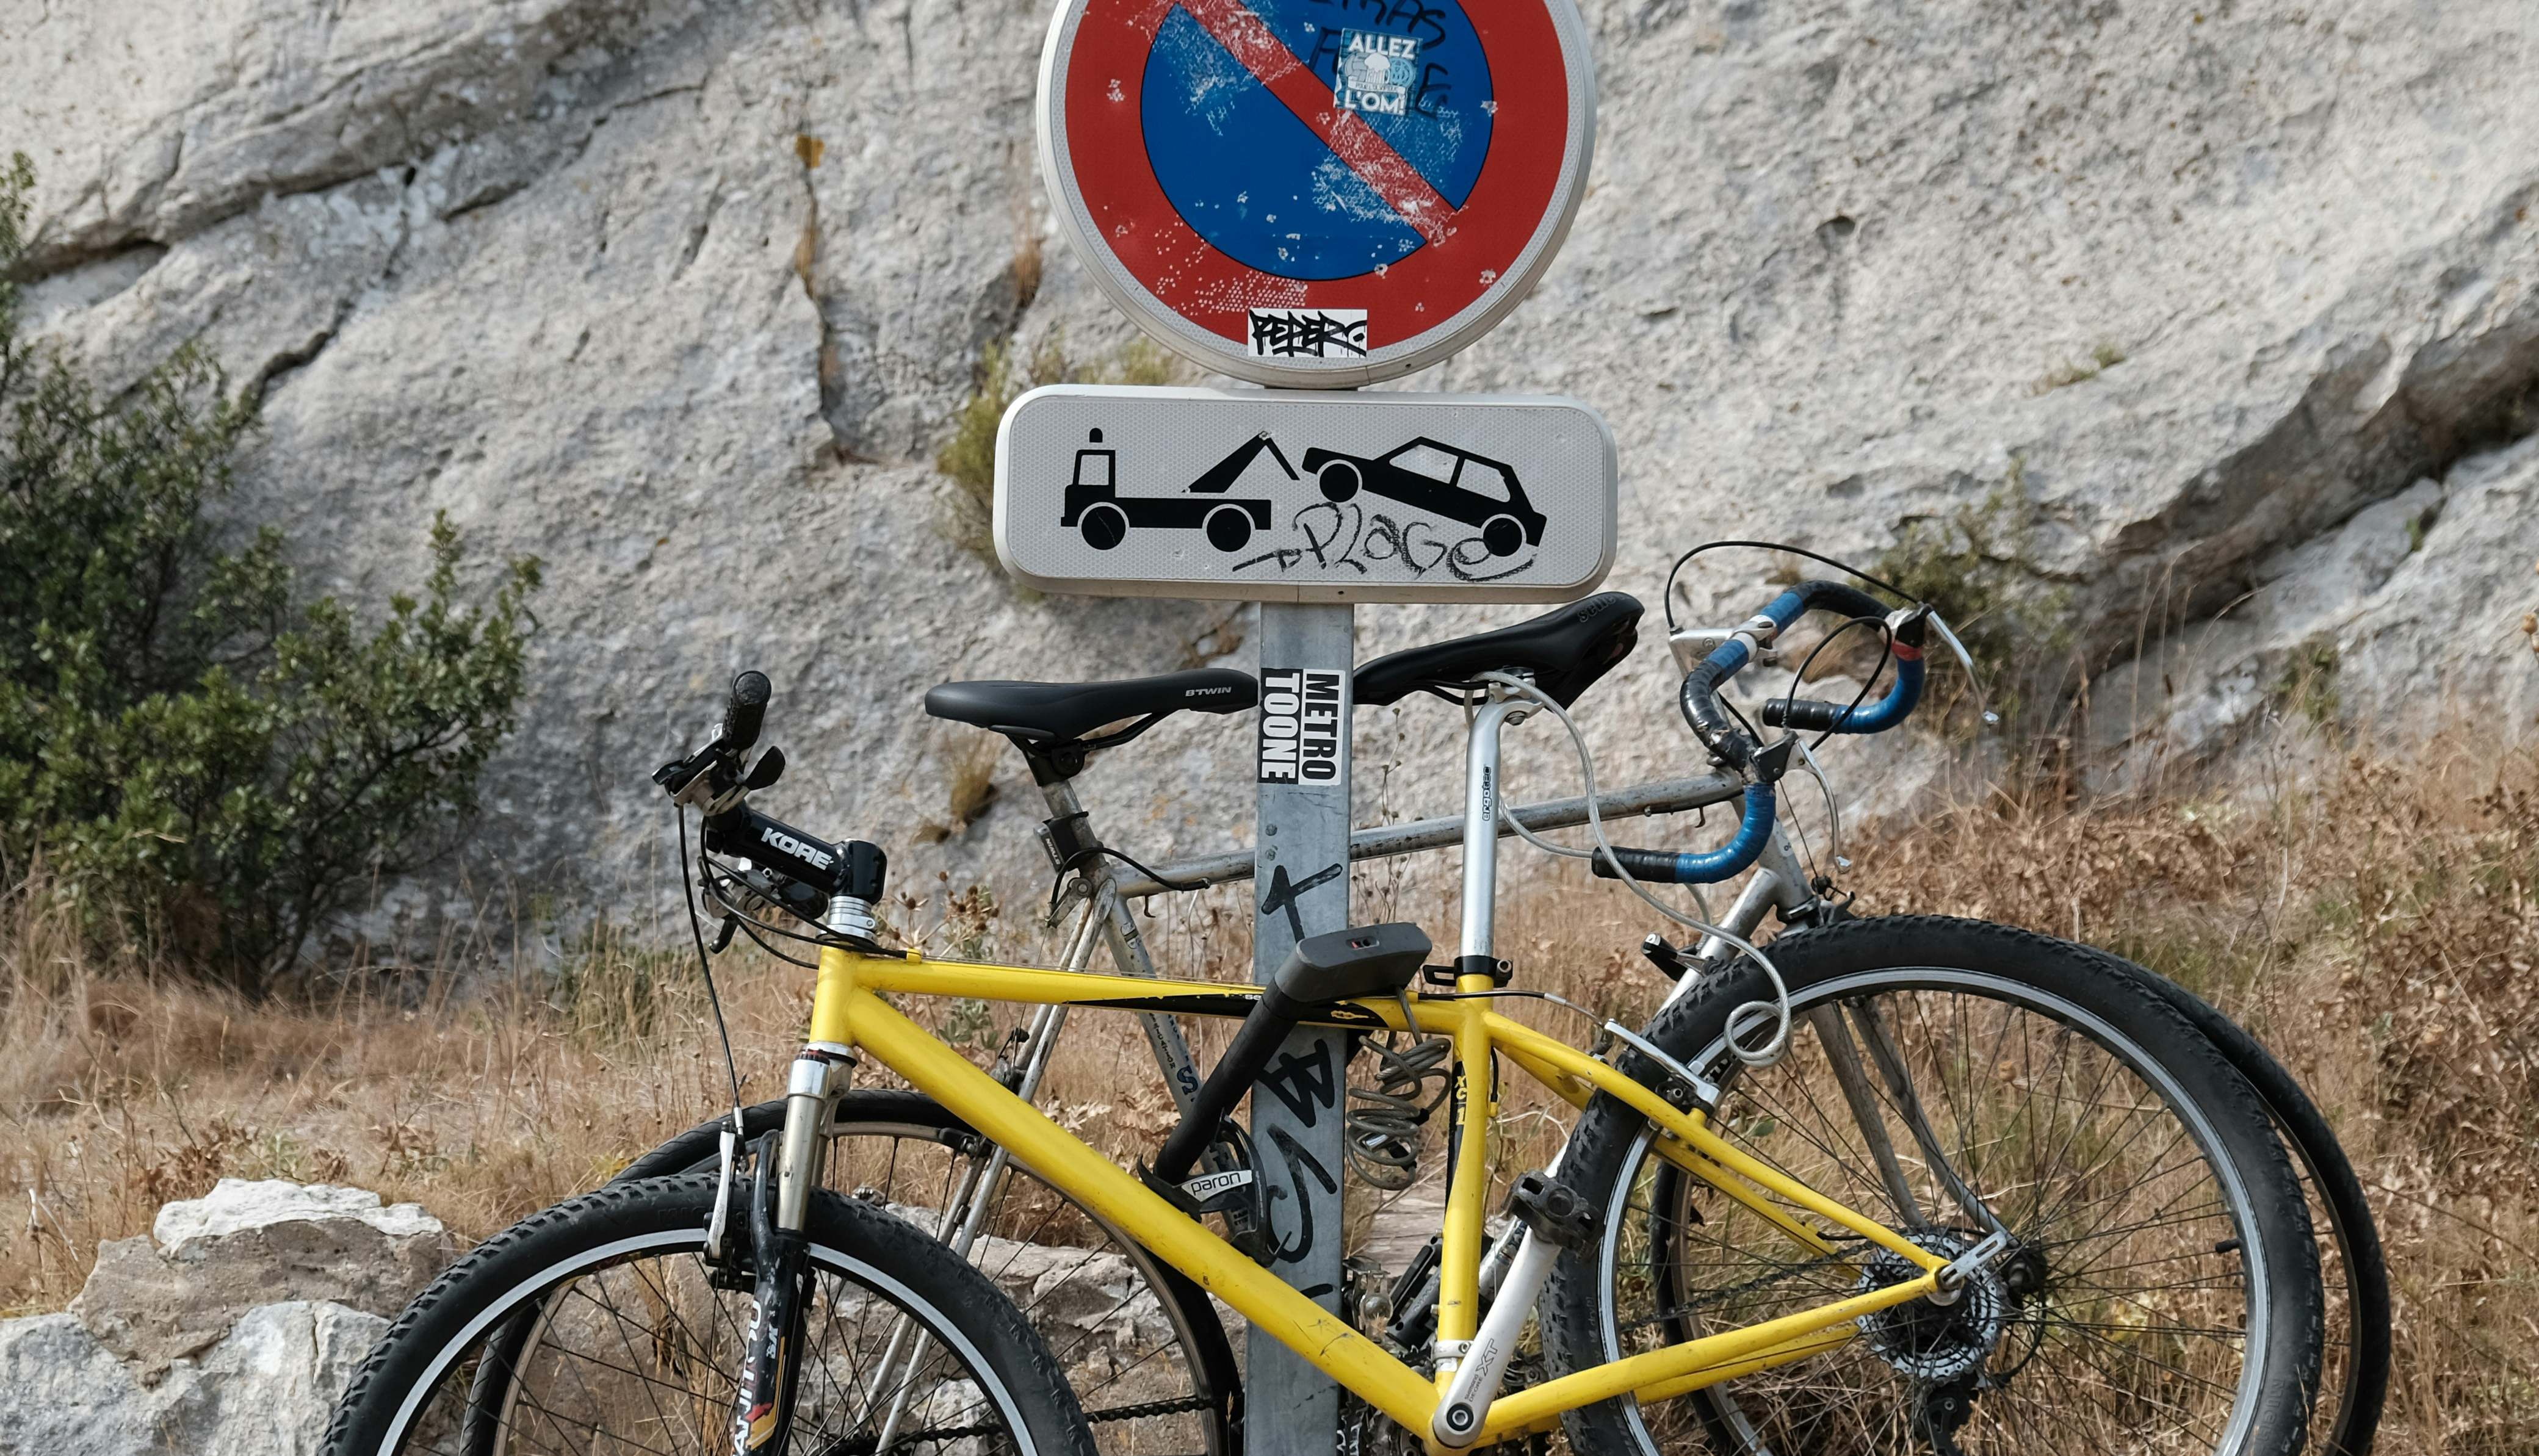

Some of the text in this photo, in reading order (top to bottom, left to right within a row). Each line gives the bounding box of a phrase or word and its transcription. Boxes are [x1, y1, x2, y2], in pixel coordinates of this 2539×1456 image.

[1348, 32, 1417, 60] ALLEZ
[1345, 90, 1405, 116] L'OM!
[1262, 672, 1301, 779] TOONE
[1302, 673, 1340, 780] METRO
[1481, 765, 1492, 821] ergotec
[760, 827, 832, 871] KORE
[1191, 1172, 1241, 1196] paron
[1475, 1338, 1498, 1377] XT
